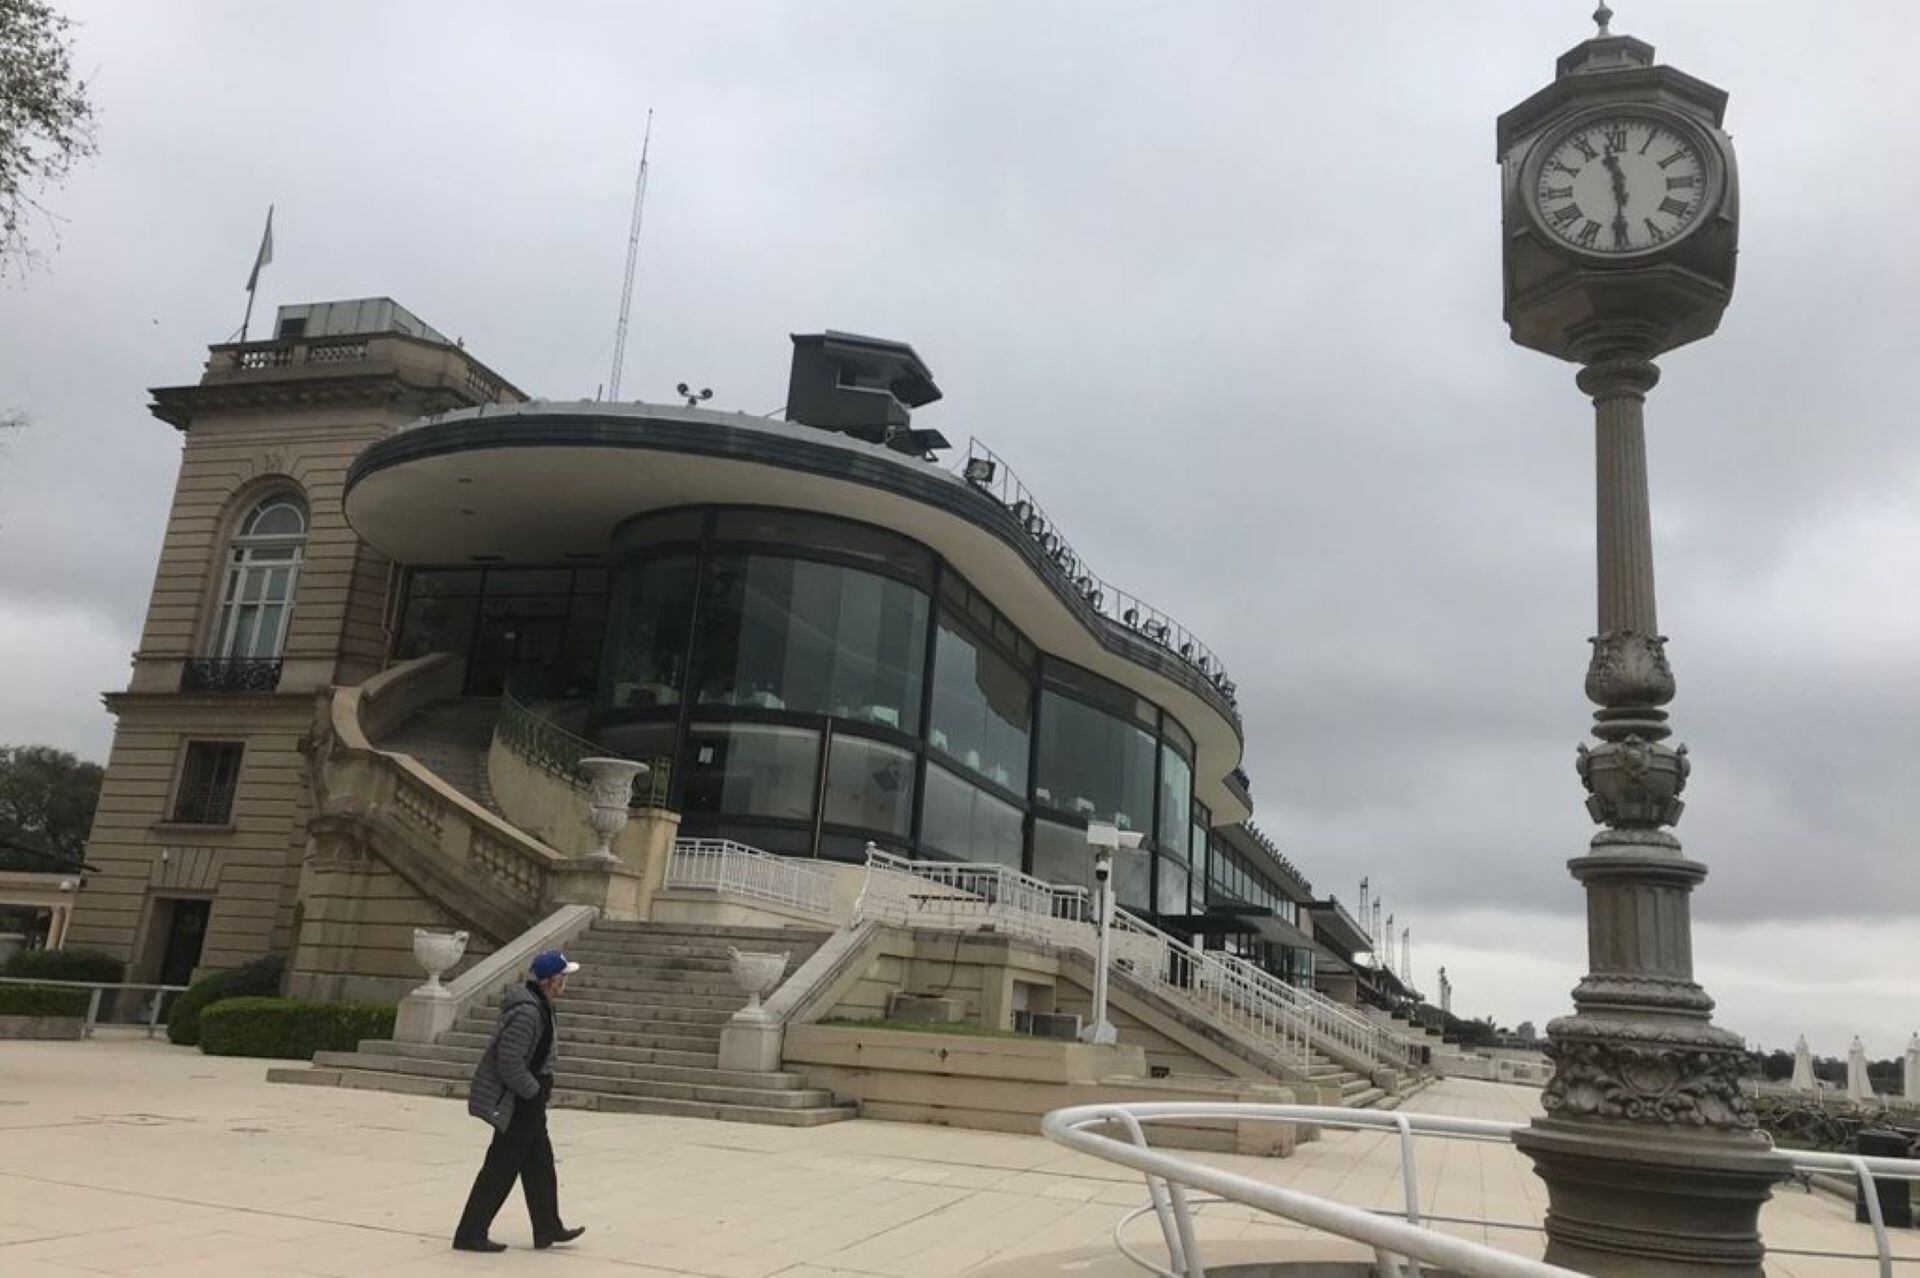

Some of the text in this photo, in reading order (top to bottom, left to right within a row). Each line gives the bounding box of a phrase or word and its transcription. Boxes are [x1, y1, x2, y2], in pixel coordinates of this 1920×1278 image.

[1605, 131, 1627, 152] XII
[1552, 162, 1580, 177] X
[1644, 218, 1664, 241] V
